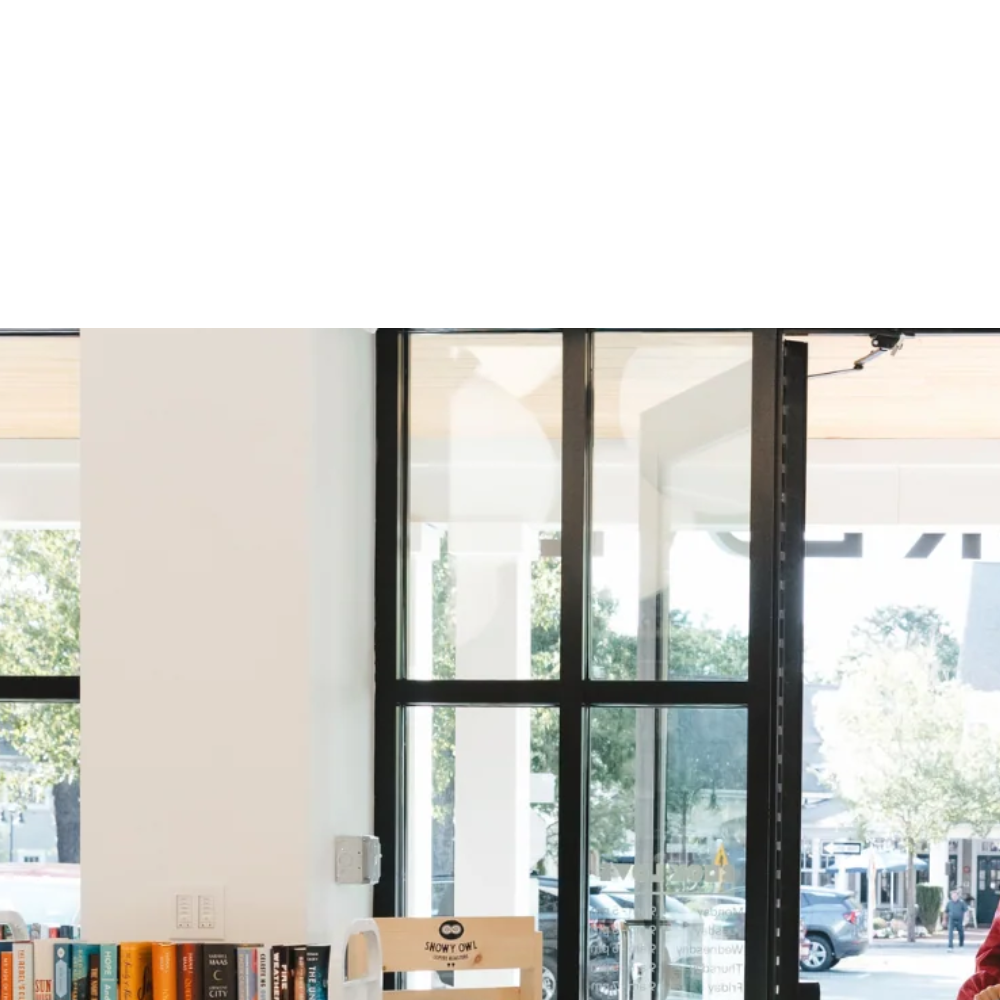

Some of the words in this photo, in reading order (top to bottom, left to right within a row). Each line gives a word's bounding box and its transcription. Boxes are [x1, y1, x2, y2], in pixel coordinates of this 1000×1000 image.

[424, 941, 456, 953] SNOWY
[458, 940, 478, 952] OWL
[104, 951, 112, 975] HOPE
[308, 966, 317, 983] THE
[35, 980, 52, 992] SUN
[208, 990, 228, 998] CITY
